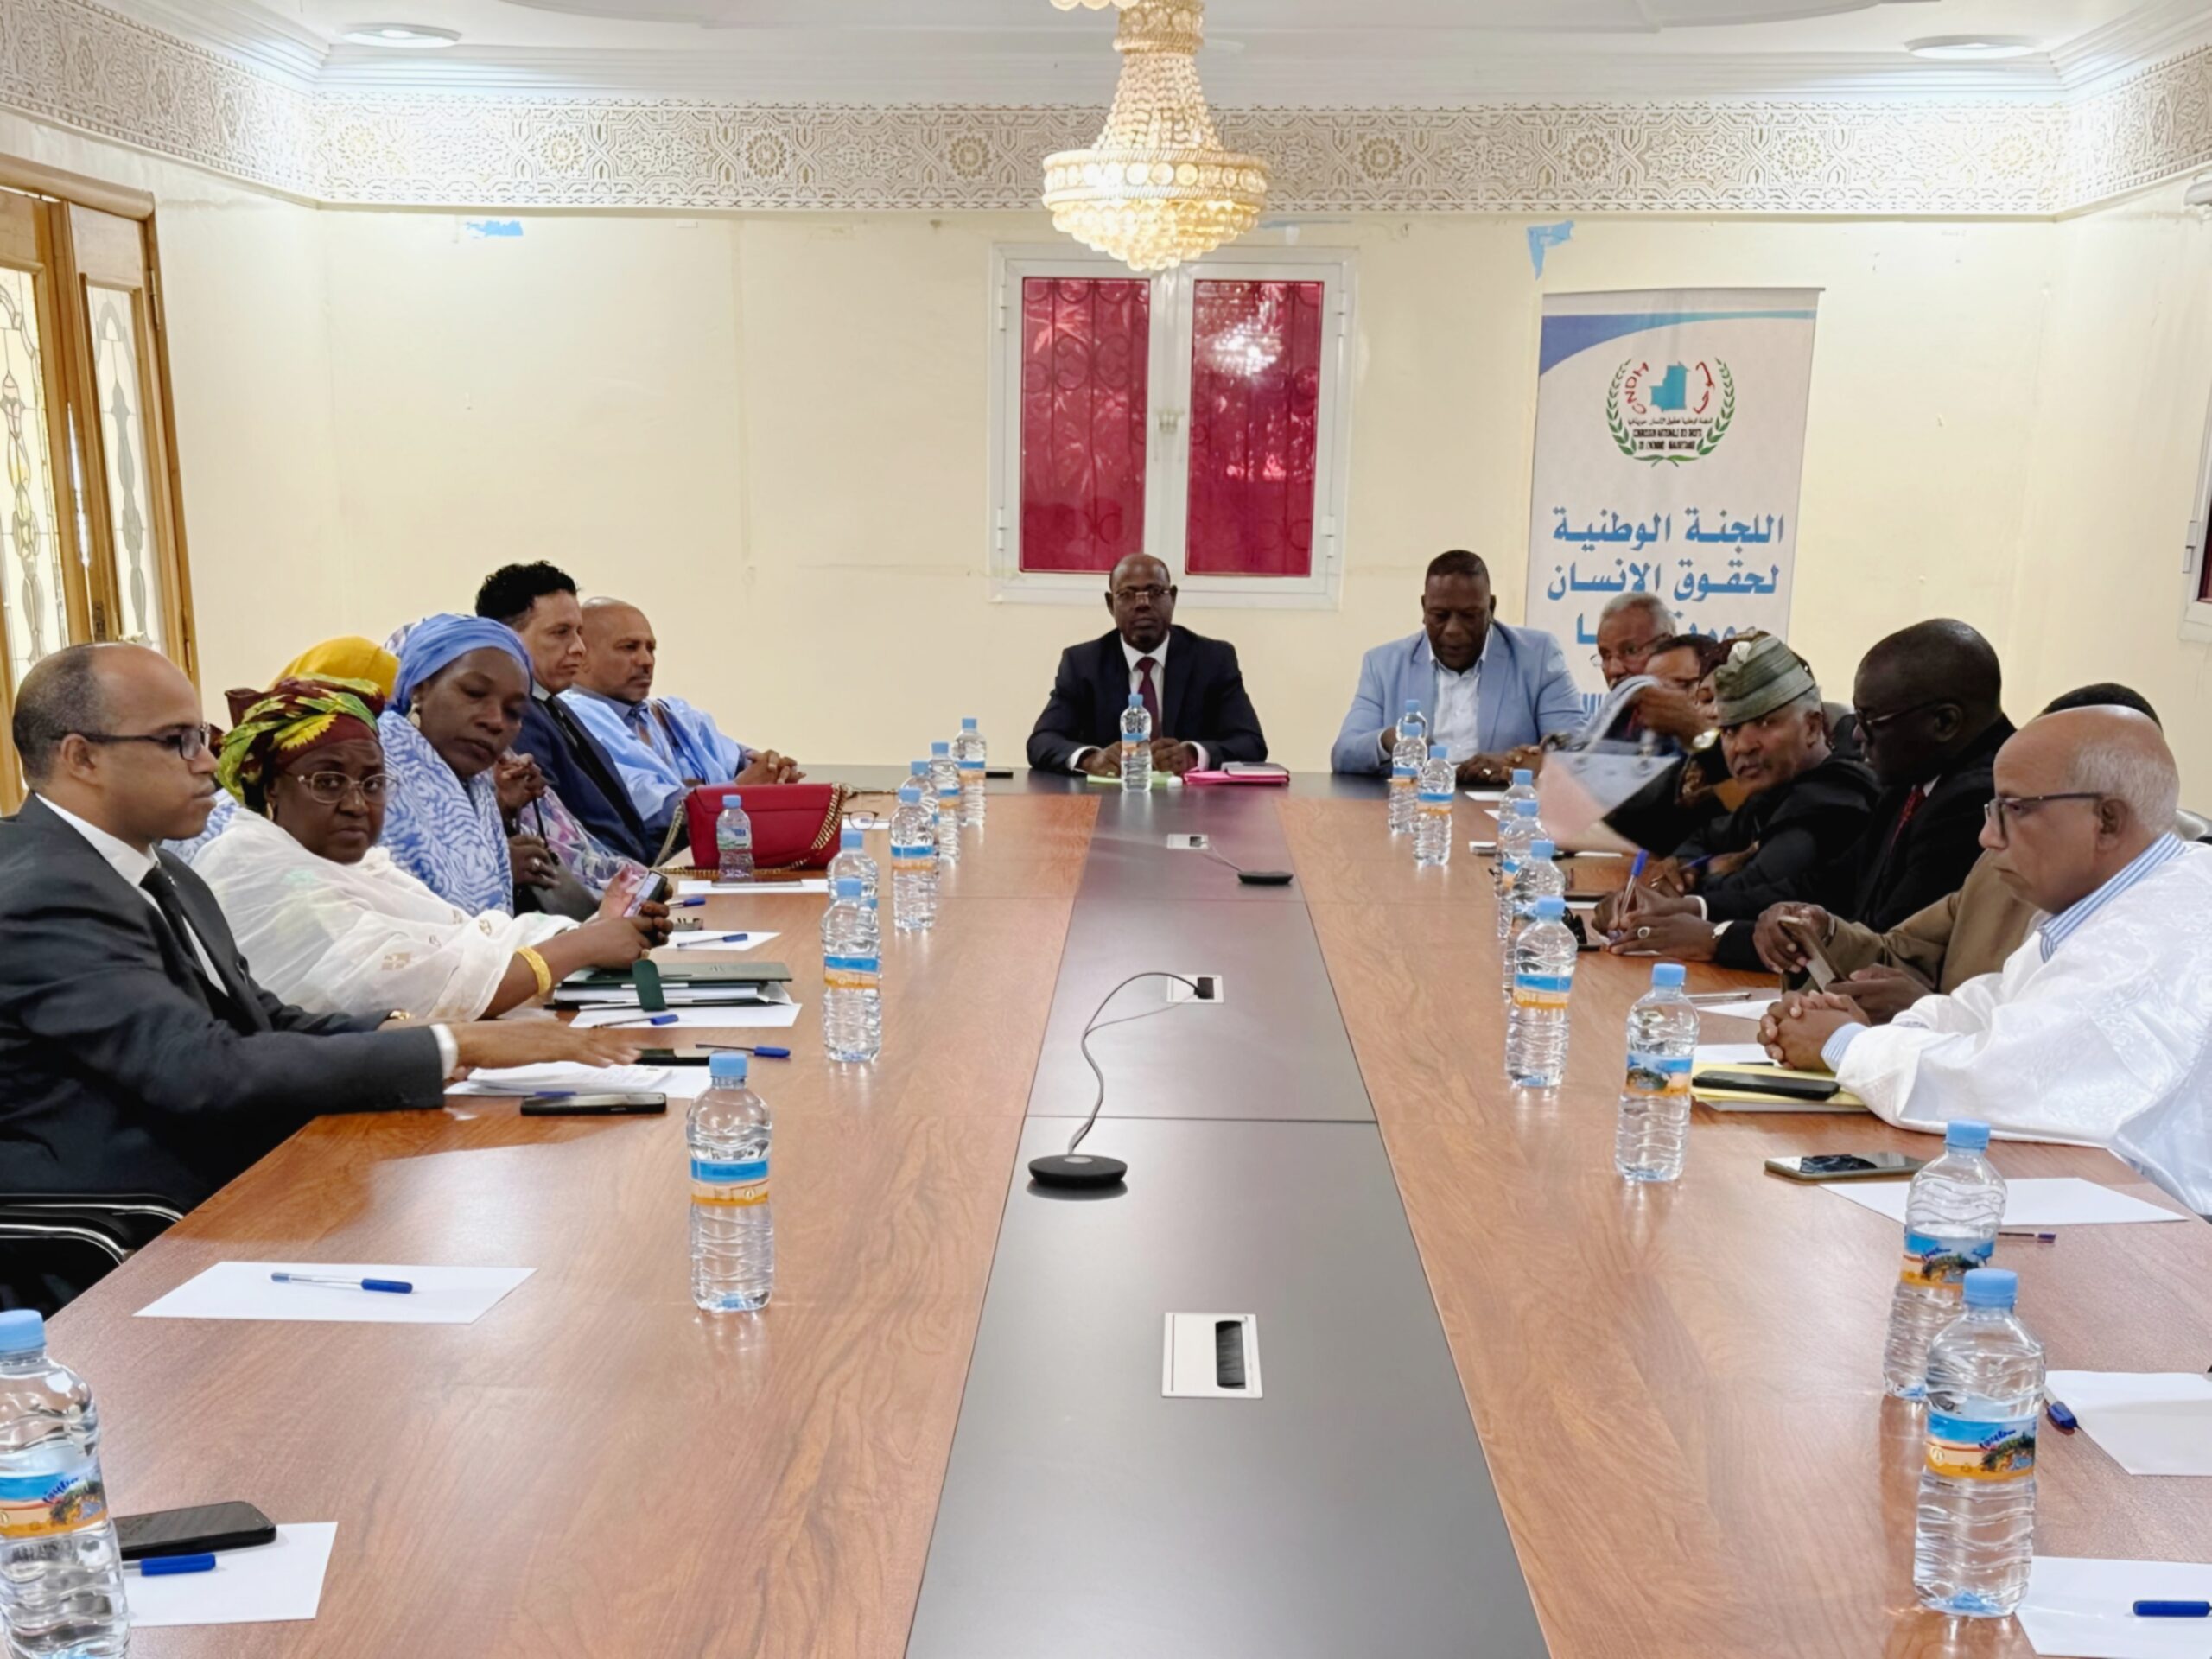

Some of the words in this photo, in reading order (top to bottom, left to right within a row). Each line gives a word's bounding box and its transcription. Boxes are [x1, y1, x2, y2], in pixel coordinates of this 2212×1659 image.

[1553, 506, 1671, 552] الوطنية
[1684, 506, 1784, 554] اللجنة
[1673, 558, 1779, 603] لحقوق
